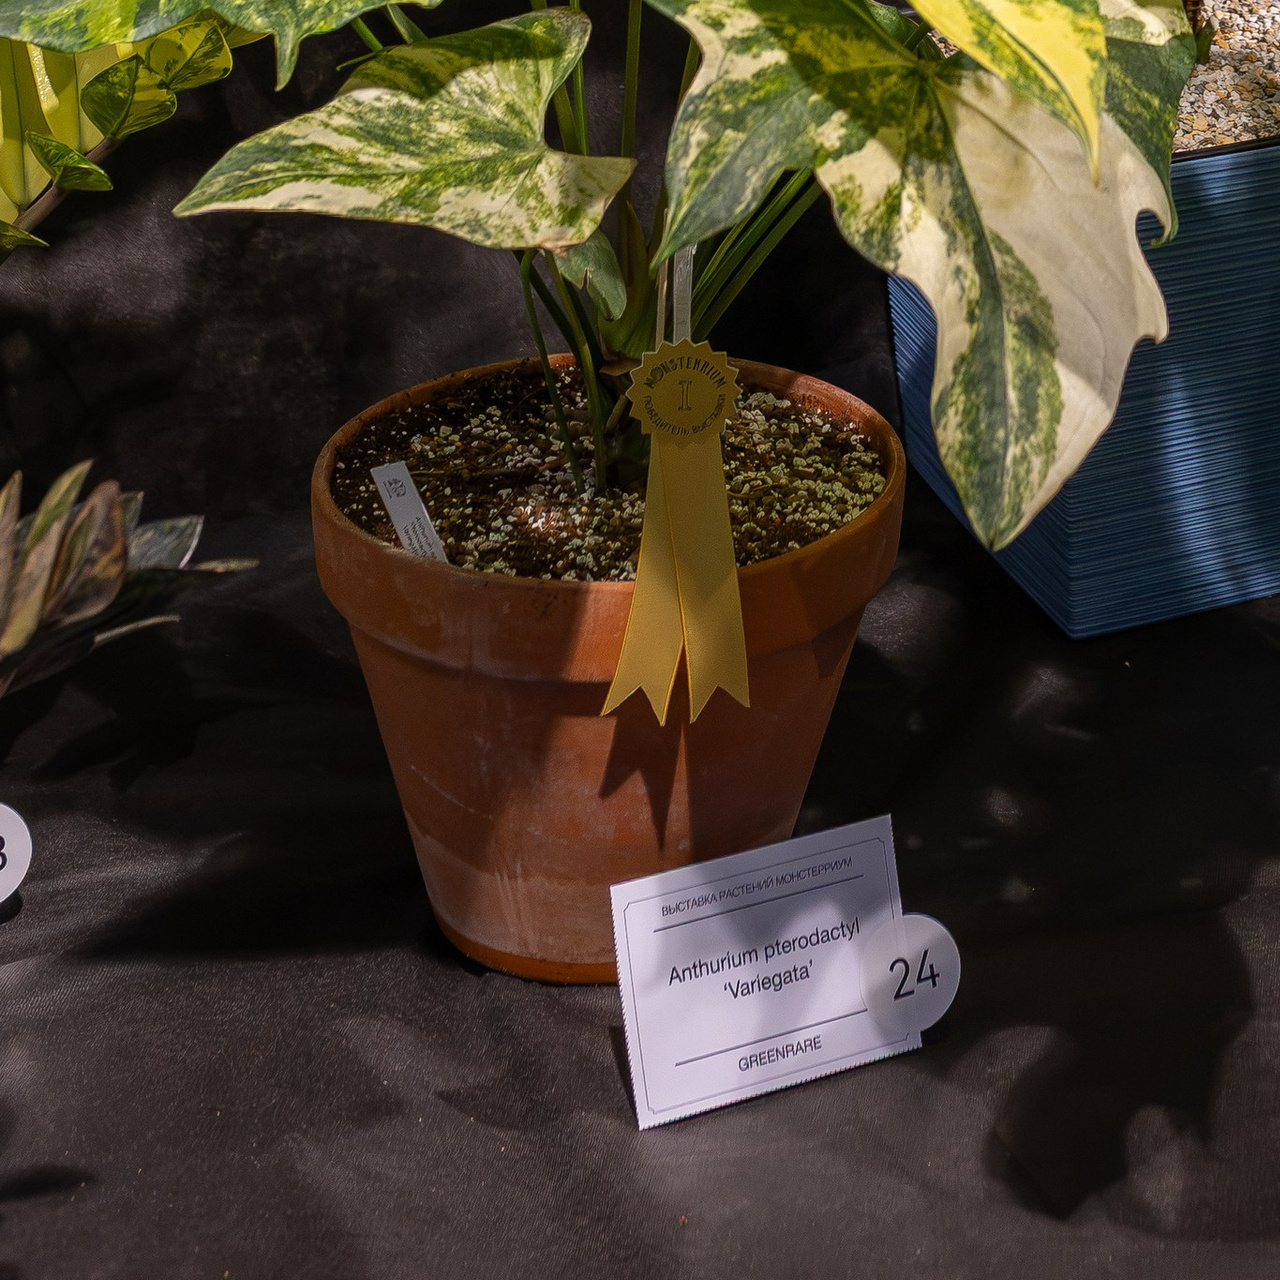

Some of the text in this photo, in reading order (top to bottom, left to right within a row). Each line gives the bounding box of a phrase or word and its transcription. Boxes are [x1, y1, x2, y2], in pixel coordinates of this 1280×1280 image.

[643, 356, 727, 389] MONSTERRIUM
[661, 857, 853, 917] ВЫСТАВКА РАСТЕНИЙ МОНСТЕРРИУМ
[668, 917, 860, 986] Anthurium pterodactyl
[888, 948, 941, 1002] 24
[738, 1035, 822, 1072] GREENRARE
